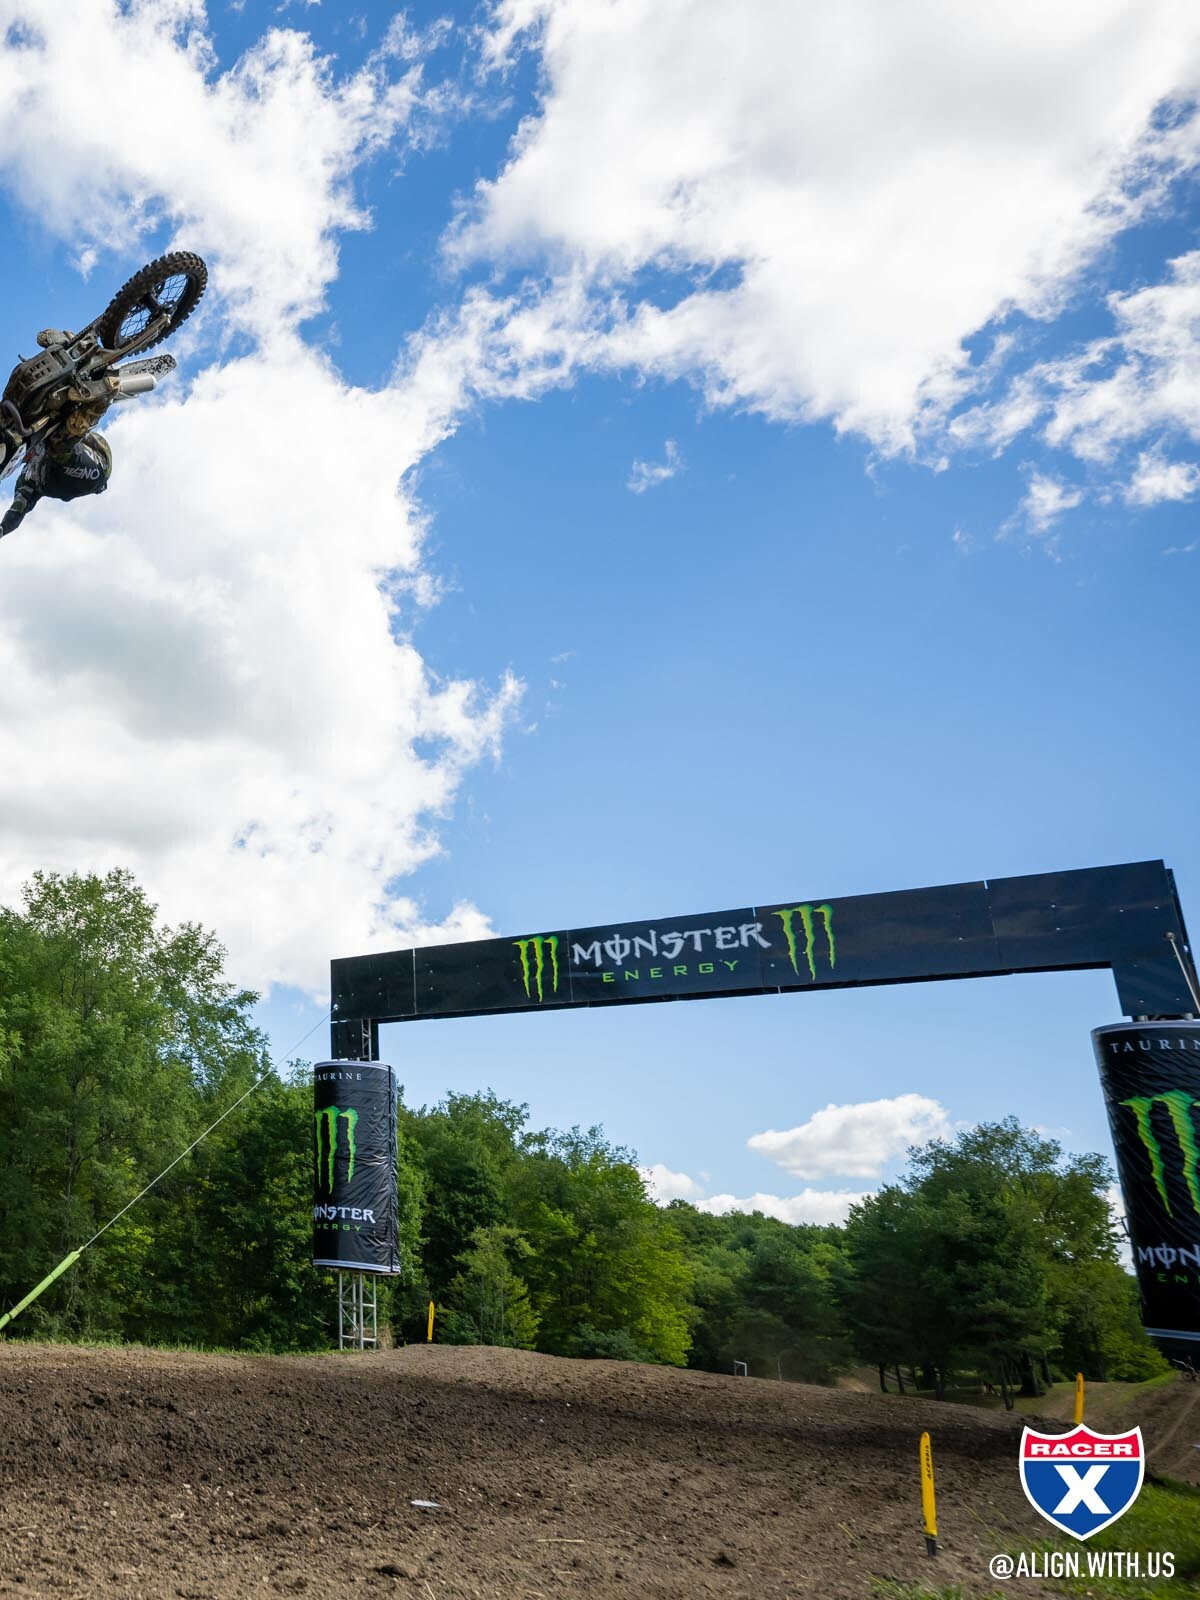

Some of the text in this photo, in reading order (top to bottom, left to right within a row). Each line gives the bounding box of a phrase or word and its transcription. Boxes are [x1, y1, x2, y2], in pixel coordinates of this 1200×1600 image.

[571, 922, 773, 967] MONSTER
[602, 960, 739, 983] ENERGY
[312, 1072, 362, 1081] AURINE
[313, 1203, 376, 1224] ONSTER
